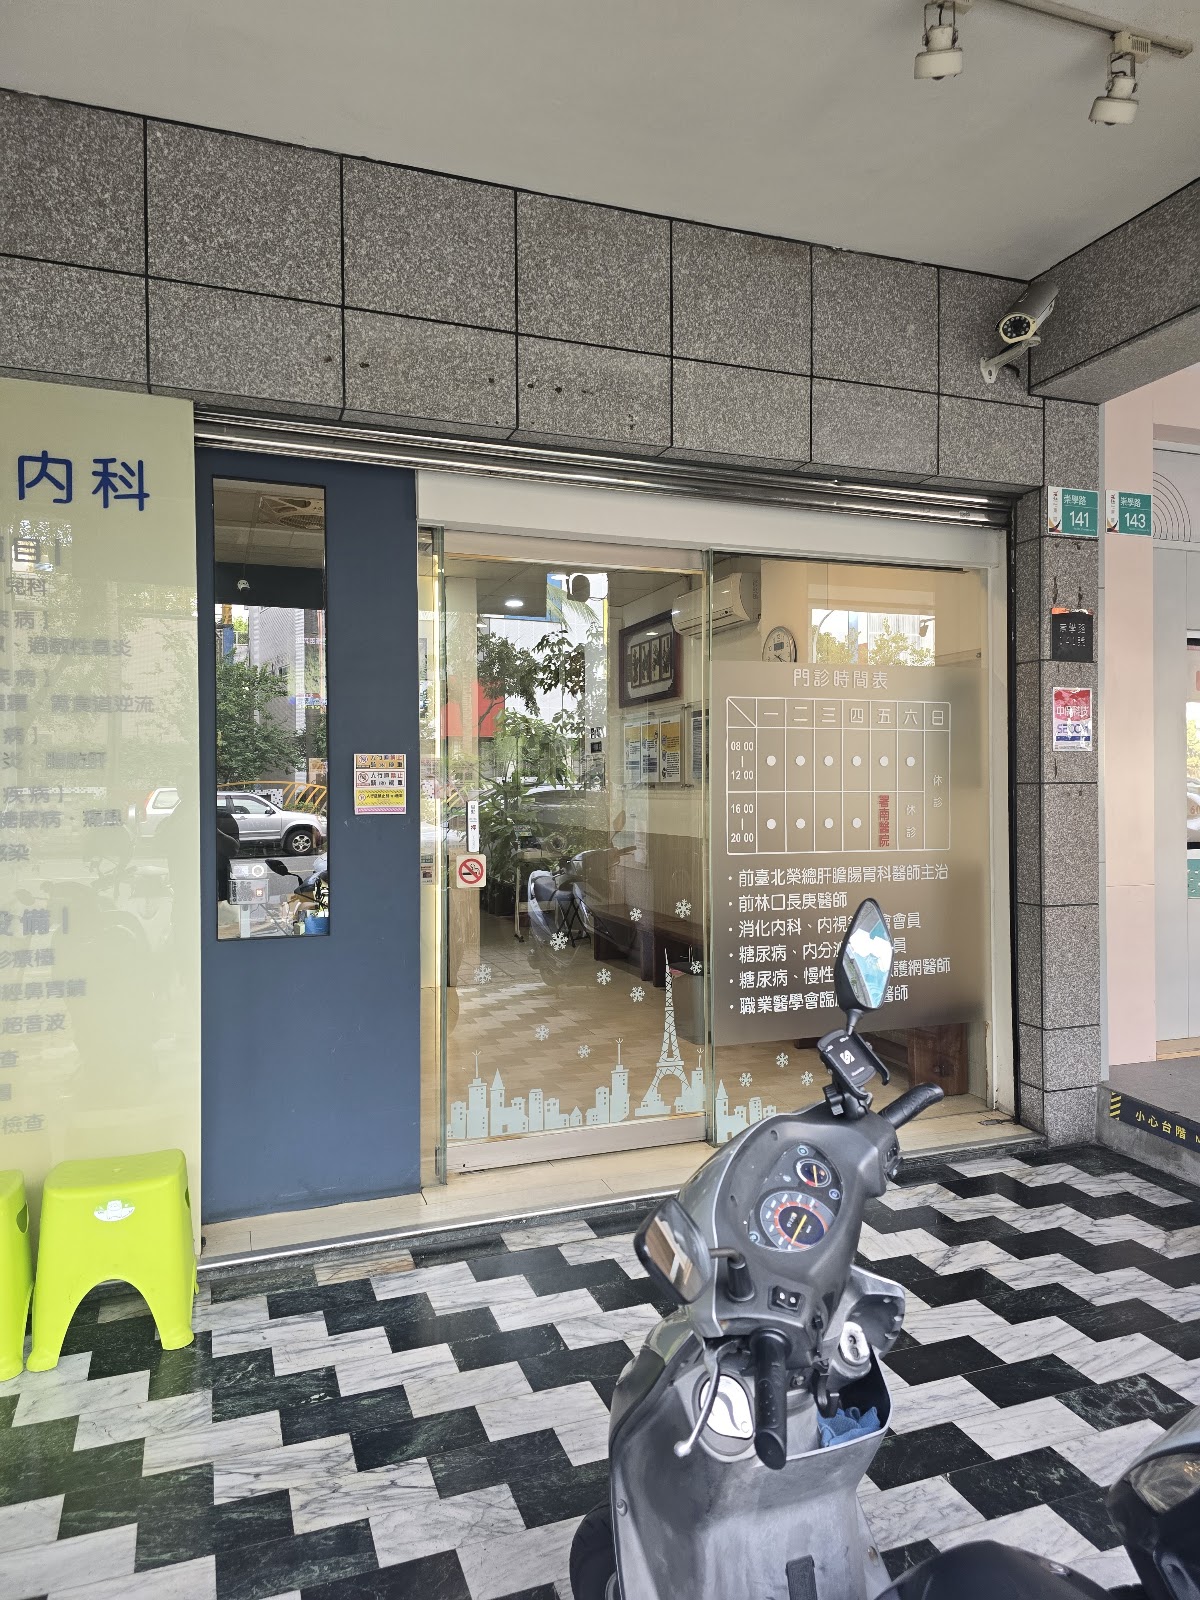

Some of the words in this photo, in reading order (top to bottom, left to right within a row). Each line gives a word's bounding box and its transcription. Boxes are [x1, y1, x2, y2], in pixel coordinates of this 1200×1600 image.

[1069, 510, 1089, 528] 141
[1124, 512, 1146, 529] 143
[793, 668, 889, 690] 門診時間表
[793, 706, 808, 722] 二
[821, 707, 836, 723] 三
[850, 708, 864, 724] 四
[877, 708, 892, 724] 五
[904, 709, 918, 725] 六
[931, 710, 944, 726] 日
[738, 863, 949, 888] 前臺北榮總肝膽腸胃科醫師主治
[738, 891, 848, 913] 前林口長庚醫師
[1135, 1110, 1187, 1141] 小心台階
